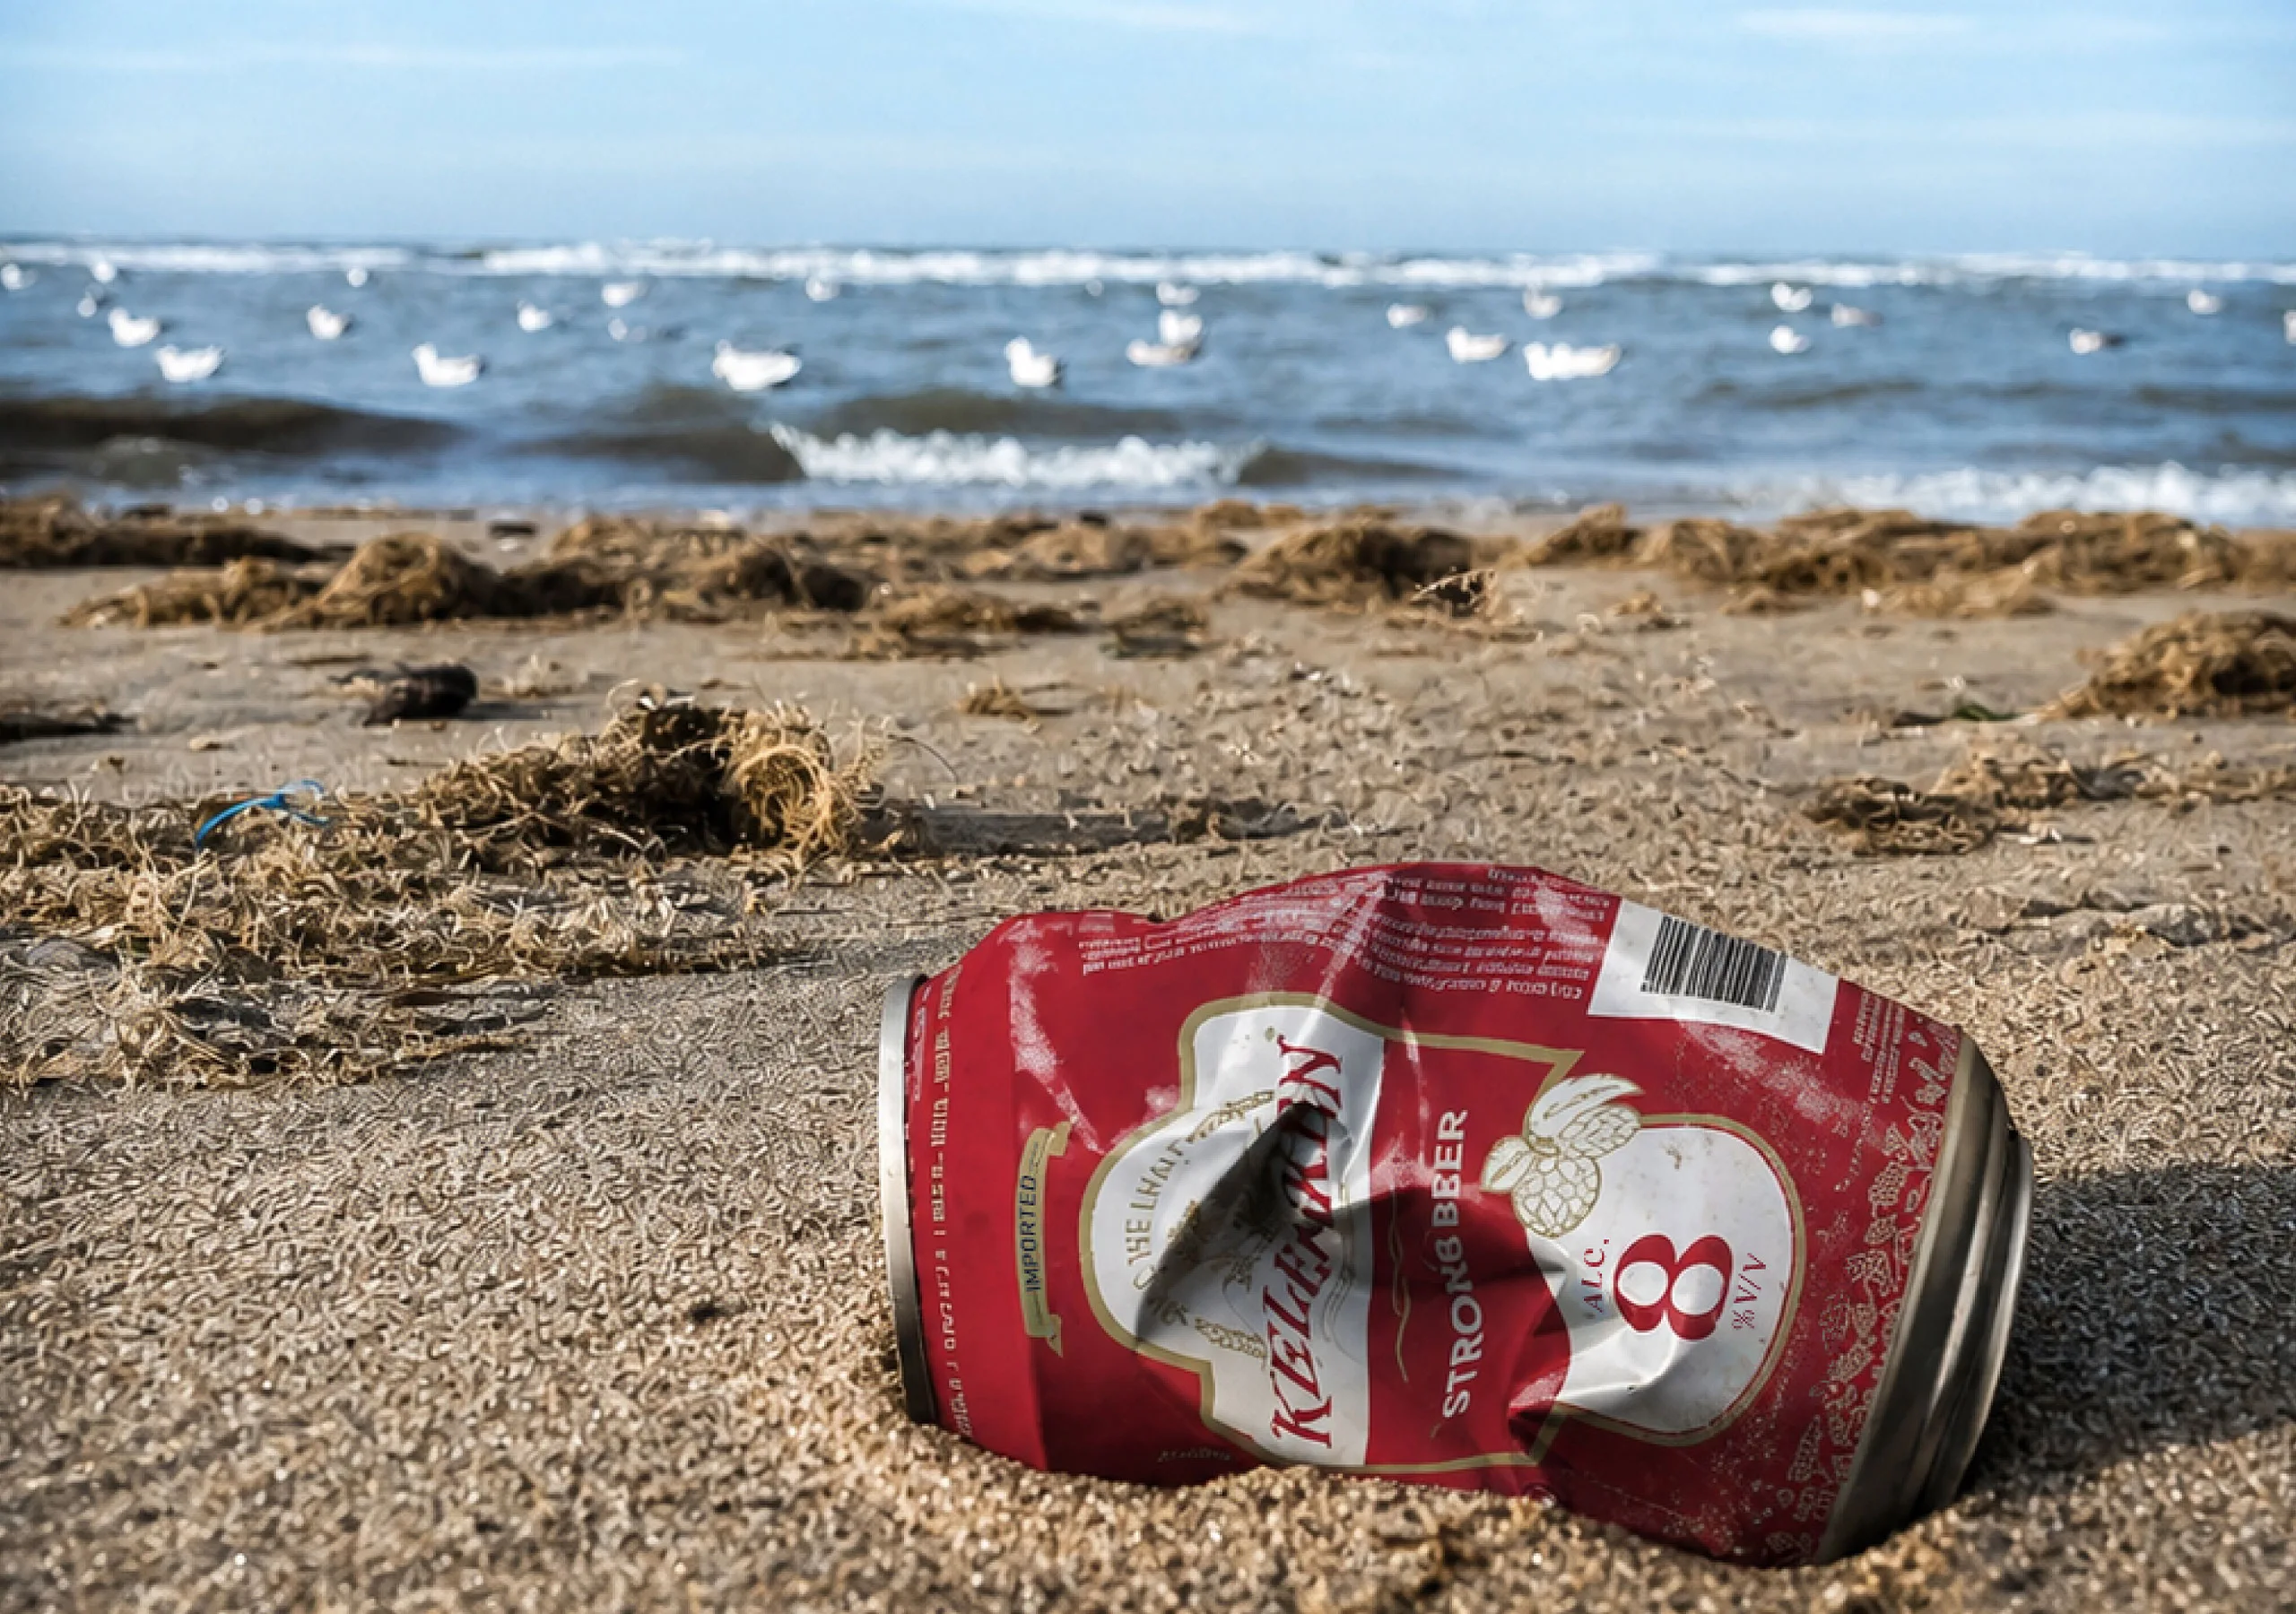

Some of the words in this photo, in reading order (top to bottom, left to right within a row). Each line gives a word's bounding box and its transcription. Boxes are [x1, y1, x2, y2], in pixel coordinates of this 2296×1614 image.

[1434, 1109, 1467, 1227] BEER
[1019, 1175, 1042, 1293] IMPORTED
[1582, 1238, 1611, 1314] ALC.
[1613, 1233, 1734, 1341] 8
